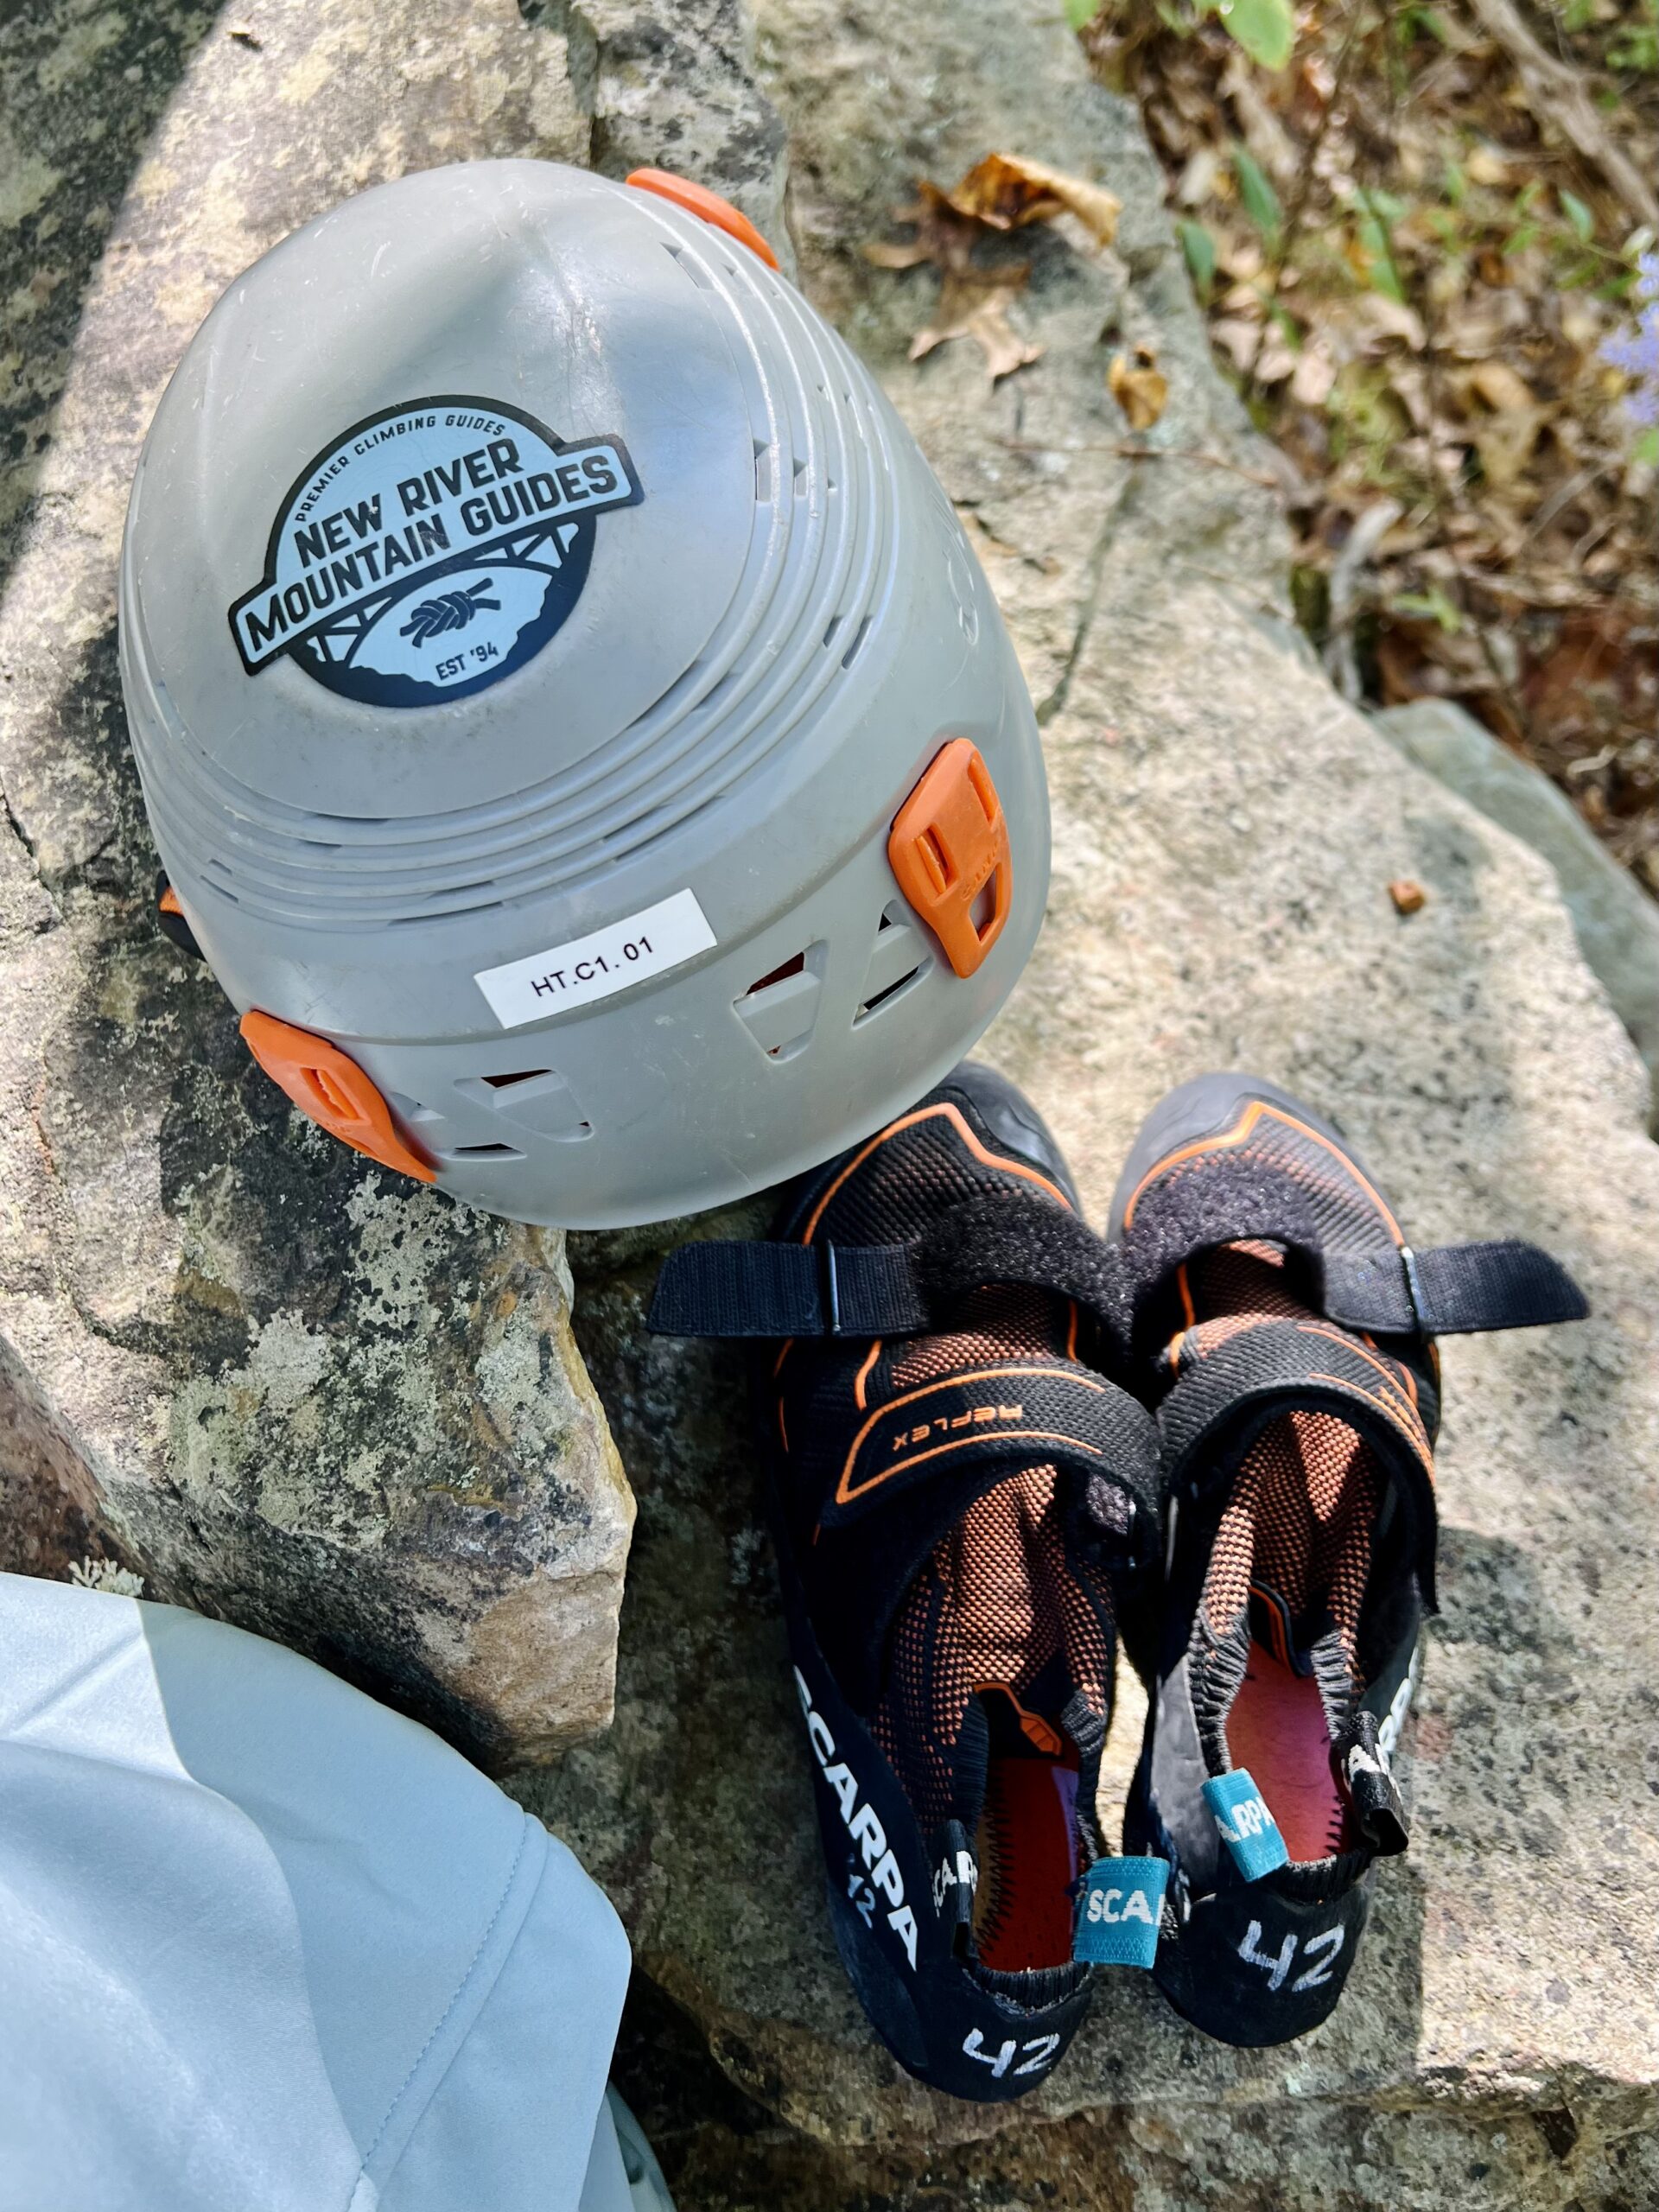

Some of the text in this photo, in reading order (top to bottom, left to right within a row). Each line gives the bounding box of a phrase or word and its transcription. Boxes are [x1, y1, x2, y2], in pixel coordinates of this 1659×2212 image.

[295, 415, 505, 522] PREMIER CLIMBING GUIDES
[294, 438, 524, 568] NEW RIVER
[245, 454, 618, 652] MOUNTAIN GUIDES
[435, 641, 499, 681] EST '94
[893, 1404, 1022, 1451] REFLEX
[1087, 1888, 1166, 1927] SCA
[1237, 1920, 1345, 1992] 42
[963, 2028, 1060, 2077] 42
